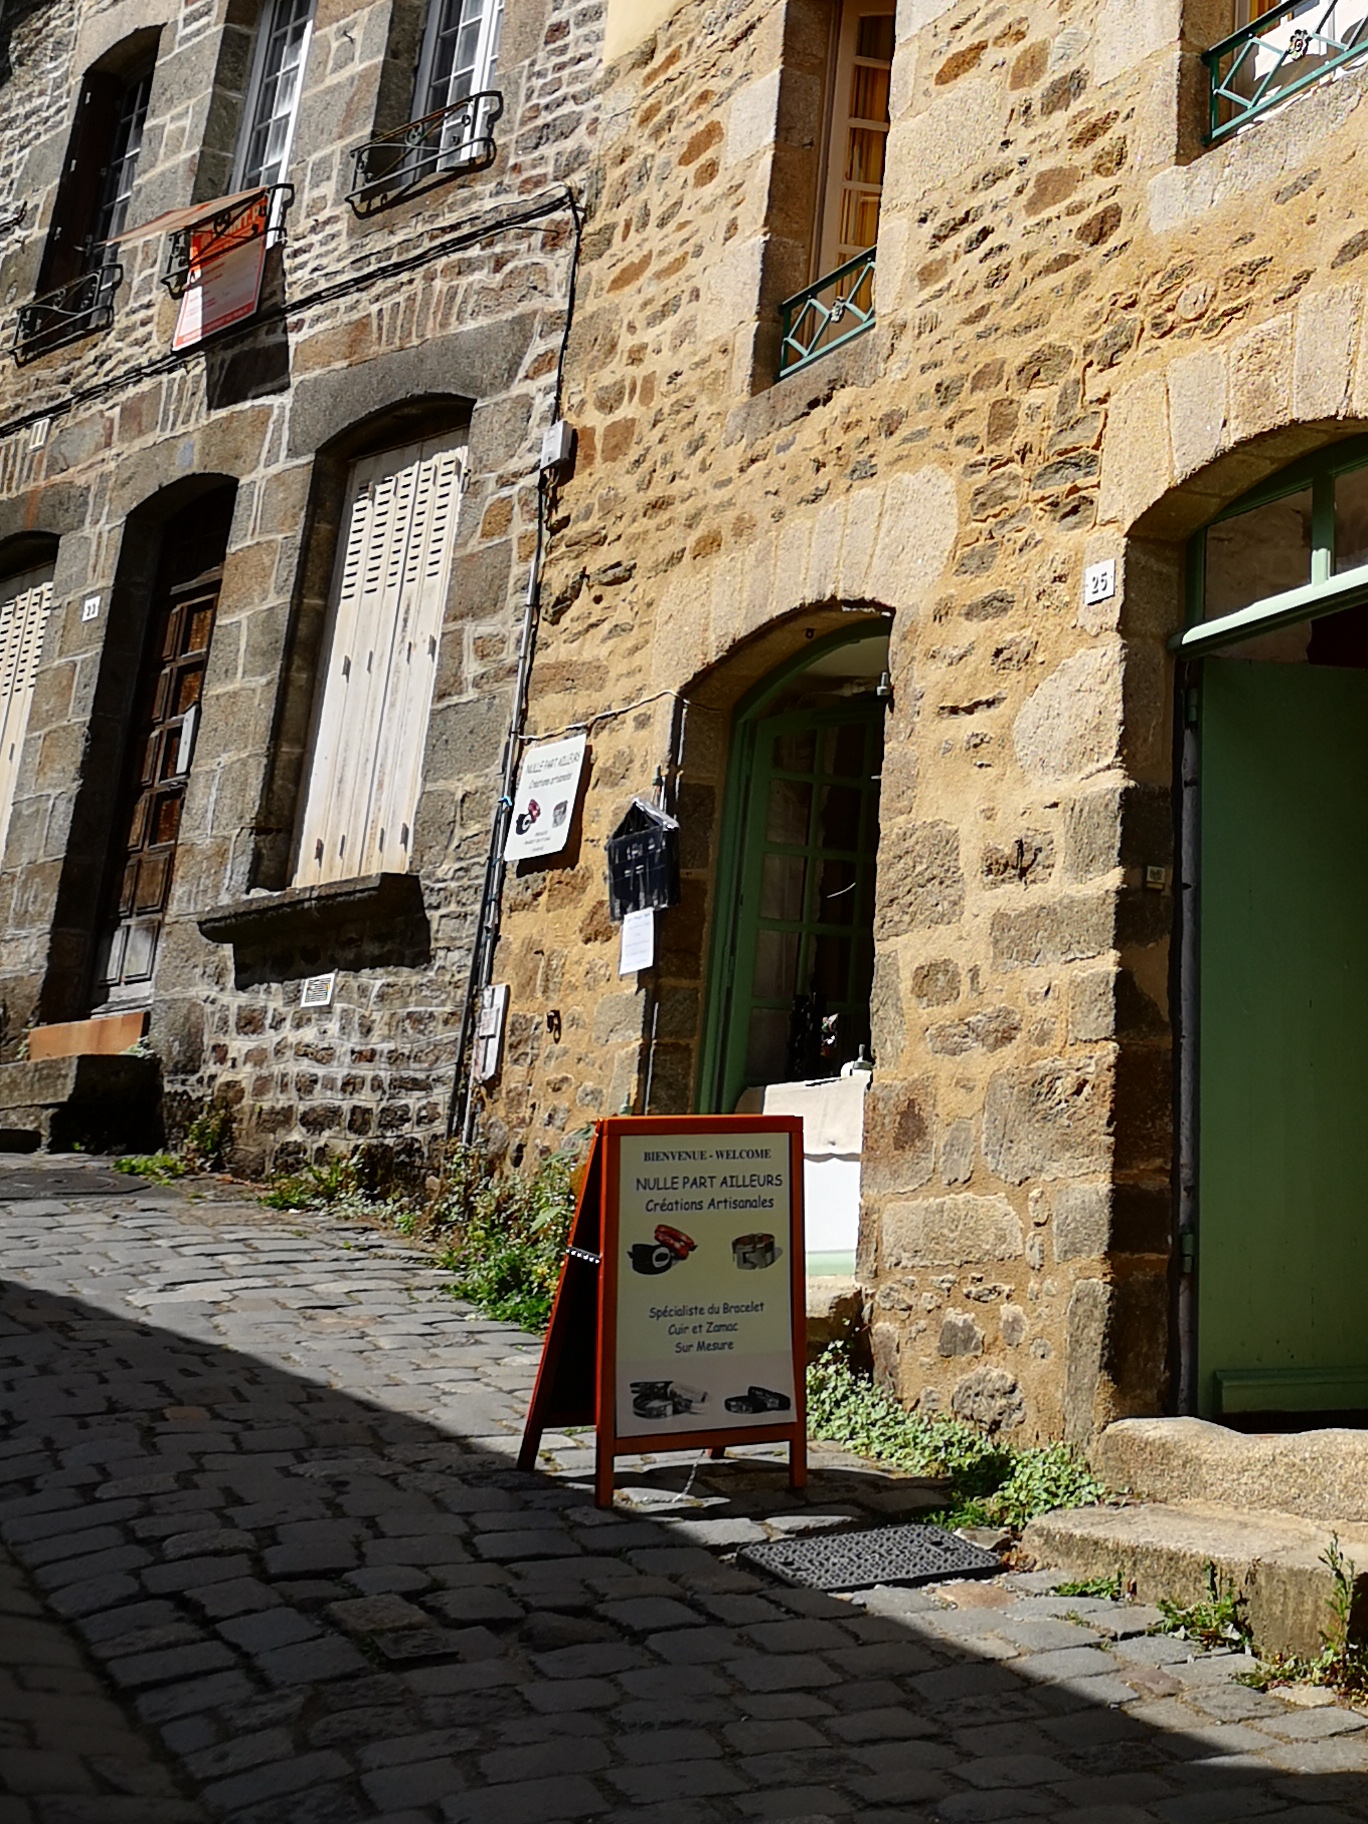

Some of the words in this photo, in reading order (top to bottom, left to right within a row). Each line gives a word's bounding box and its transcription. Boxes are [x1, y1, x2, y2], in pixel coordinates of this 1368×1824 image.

[1092, 572, 1107, 594] 25
[643, 1150, 707, 1162] BIENVENUE
[715, 1149, 772, 1160] WELCOME
[636, 1176, 679, 1191] NULLE
[682, 1176, 717, 1189] PART
[720, 1174, 783, 1188] AILLEURS
[645, 1198, 703, 1212] Créations
[707, 1194, 774, 1210] Artisanales
[649, 1305, 705, 1321] Spécialiste
[708, 1303, 720, 1315] du
[722, 1300, 764, 1314] Bracelet
[668, 1323, 689, 1335] Cuir
[692, 1324, 703, 1334] et
[706, 1321, 739, 1333] Zamac
[675, 1342, 694, 1354] Sur
[696, 1340, 734, 1352] Mesure
